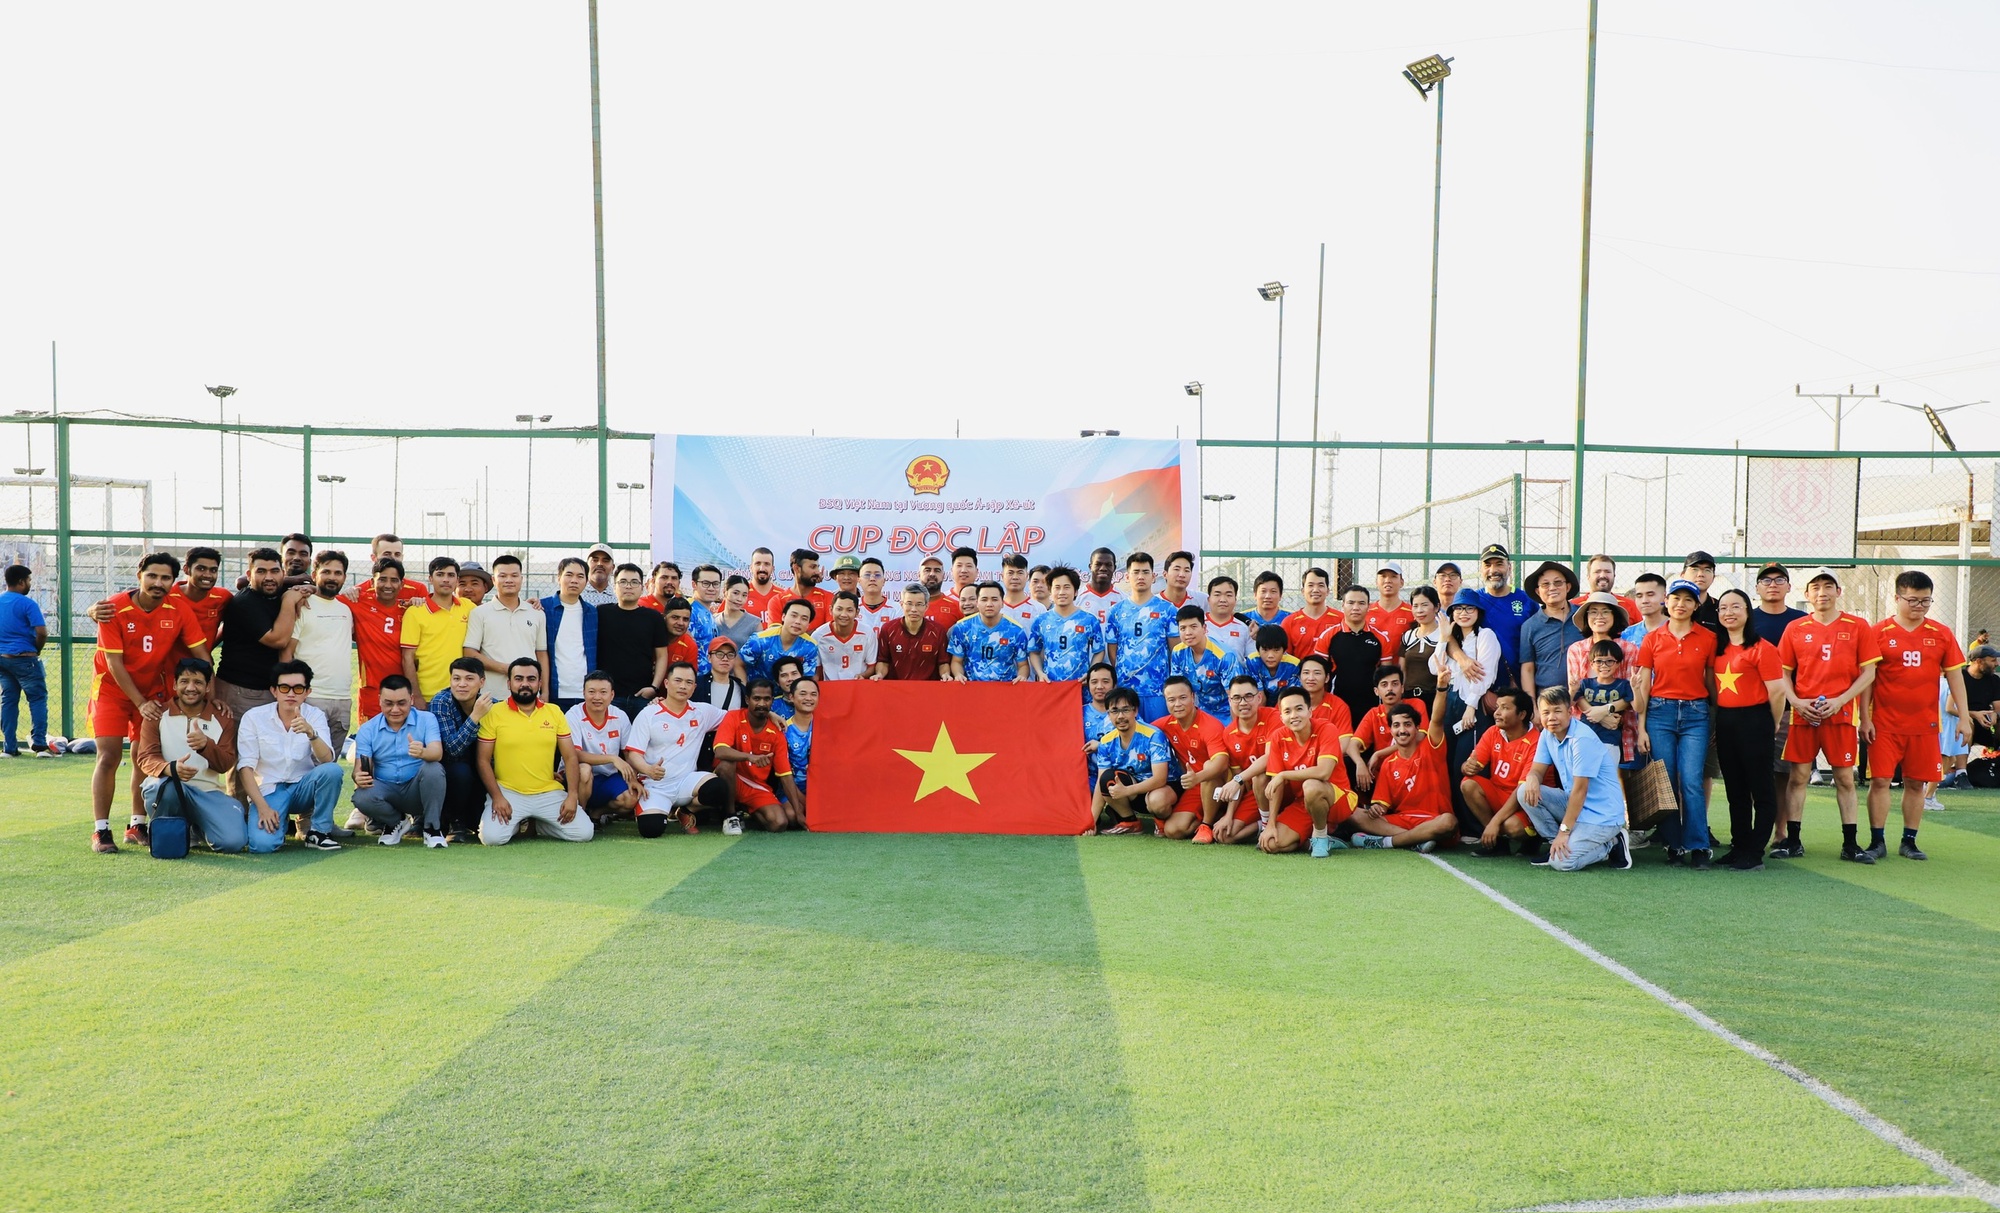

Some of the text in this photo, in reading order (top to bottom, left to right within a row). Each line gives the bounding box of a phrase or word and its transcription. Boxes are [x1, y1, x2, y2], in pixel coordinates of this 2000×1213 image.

[819, 498, 843, 511] ĐSQ
[844, 498, 866, 512] Việt
[867, 499, 892, 511] Nam
[894, 499, 909, 513] tại
[910, 499, 945, 514] Vương
[946, 498, 974, 514] quốc
[808, 521, 1046, 557] CUP ĐỘC LẬP
[1098, 610, 1106, 624] 5
[383, 617, 395, 634] 2
[1134, 622, 1143, 637] 6
[142, 635, 153, 653] 6
[1059, 635, 1067, 650] 9
[981, 645, 994, 660] 10
[1821, 644, 1832, 661] 5
[1902, 650, 1922, 667] 99
[841, 655, 850, 669] 9
[1584, 688, 1620, 704] GAP
[676, 733, 685, 747] 4
[1494, 759, 1511, 779] 19
